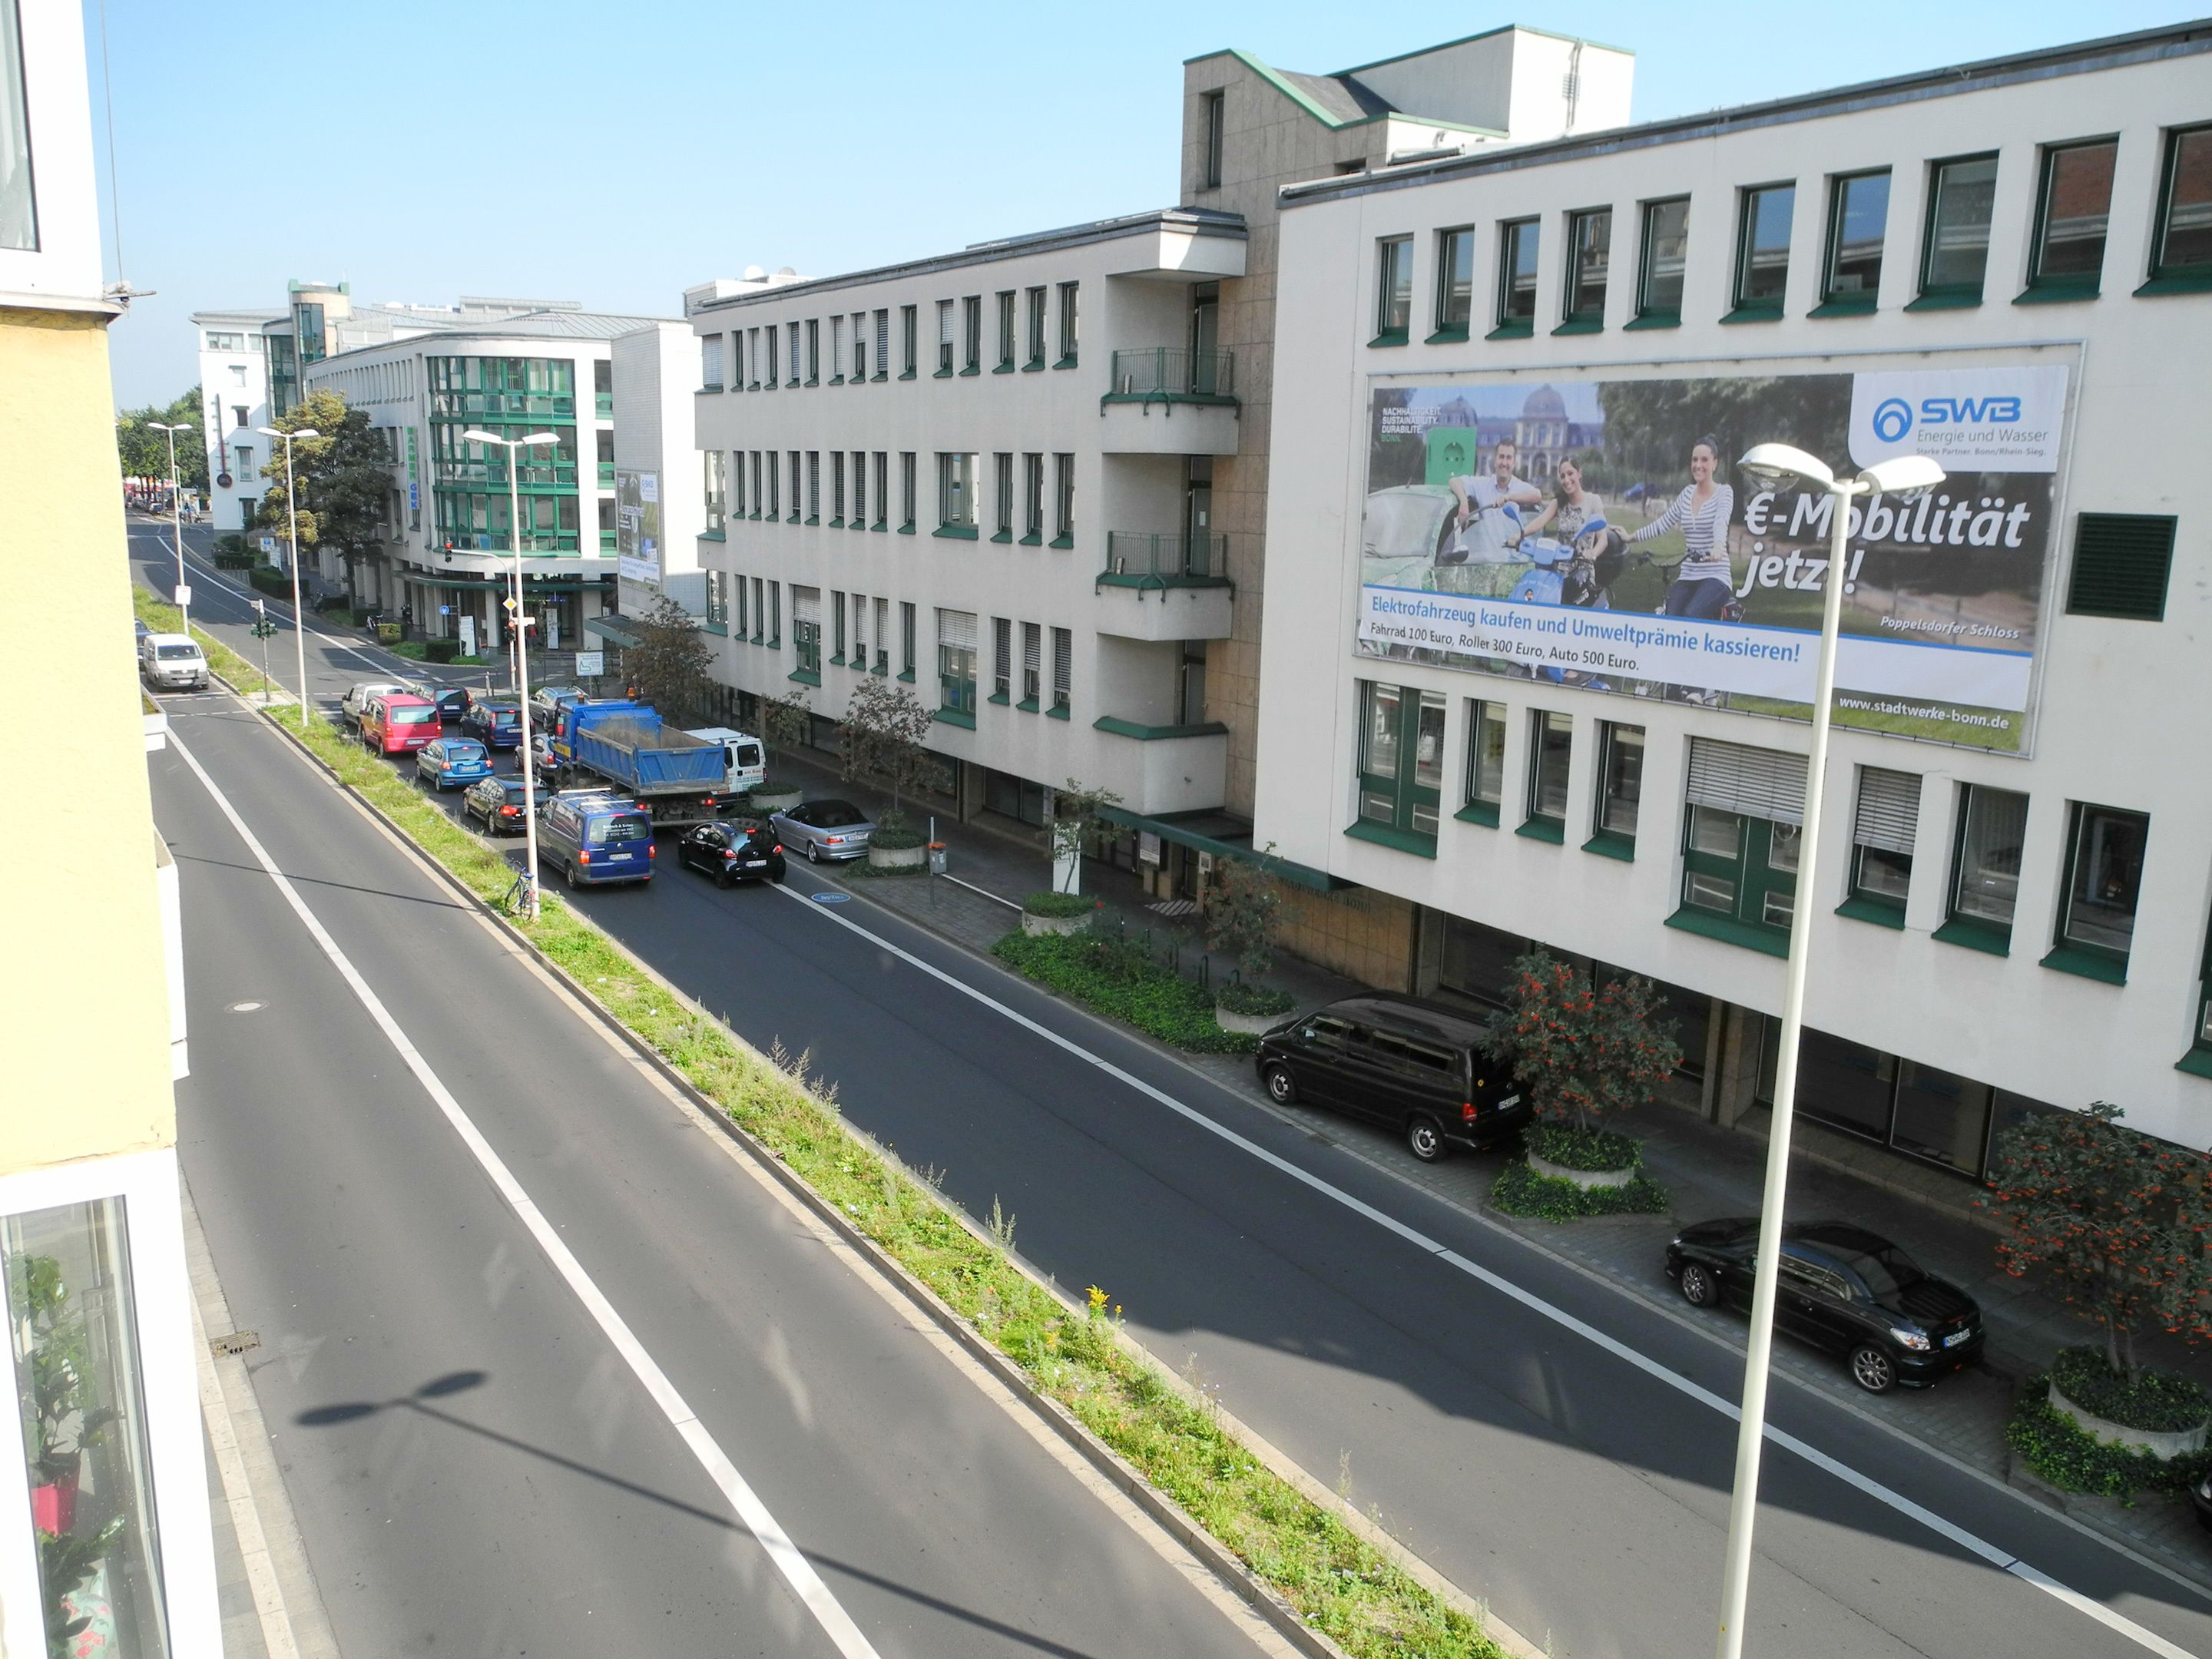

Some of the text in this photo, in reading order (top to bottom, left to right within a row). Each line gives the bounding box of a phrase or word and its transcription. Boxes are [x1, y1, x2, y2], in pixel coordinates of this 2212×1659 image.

[1382, 416, 1439, 424] SUSTAINABILITY.
[1921, 396, 2022, 422] SWB
[1917, 429, 2048, 445] Energie und Wasser
[1736, 541, 1865, 598] jetz!
[1373, 596, 1800, 662] Elektrofahrzeug kaufen und Umweltprämie kassieren!
[1881, 616, 2020, 639] Poppelsdorfer Schloss
[1370, 622, 1640, 671] Fahrrad 100 Euro, Roller 300 Euro, Auto 500 Euro.
[1839, 697, 2009, 729] www.stadtwerke-bonn.de
